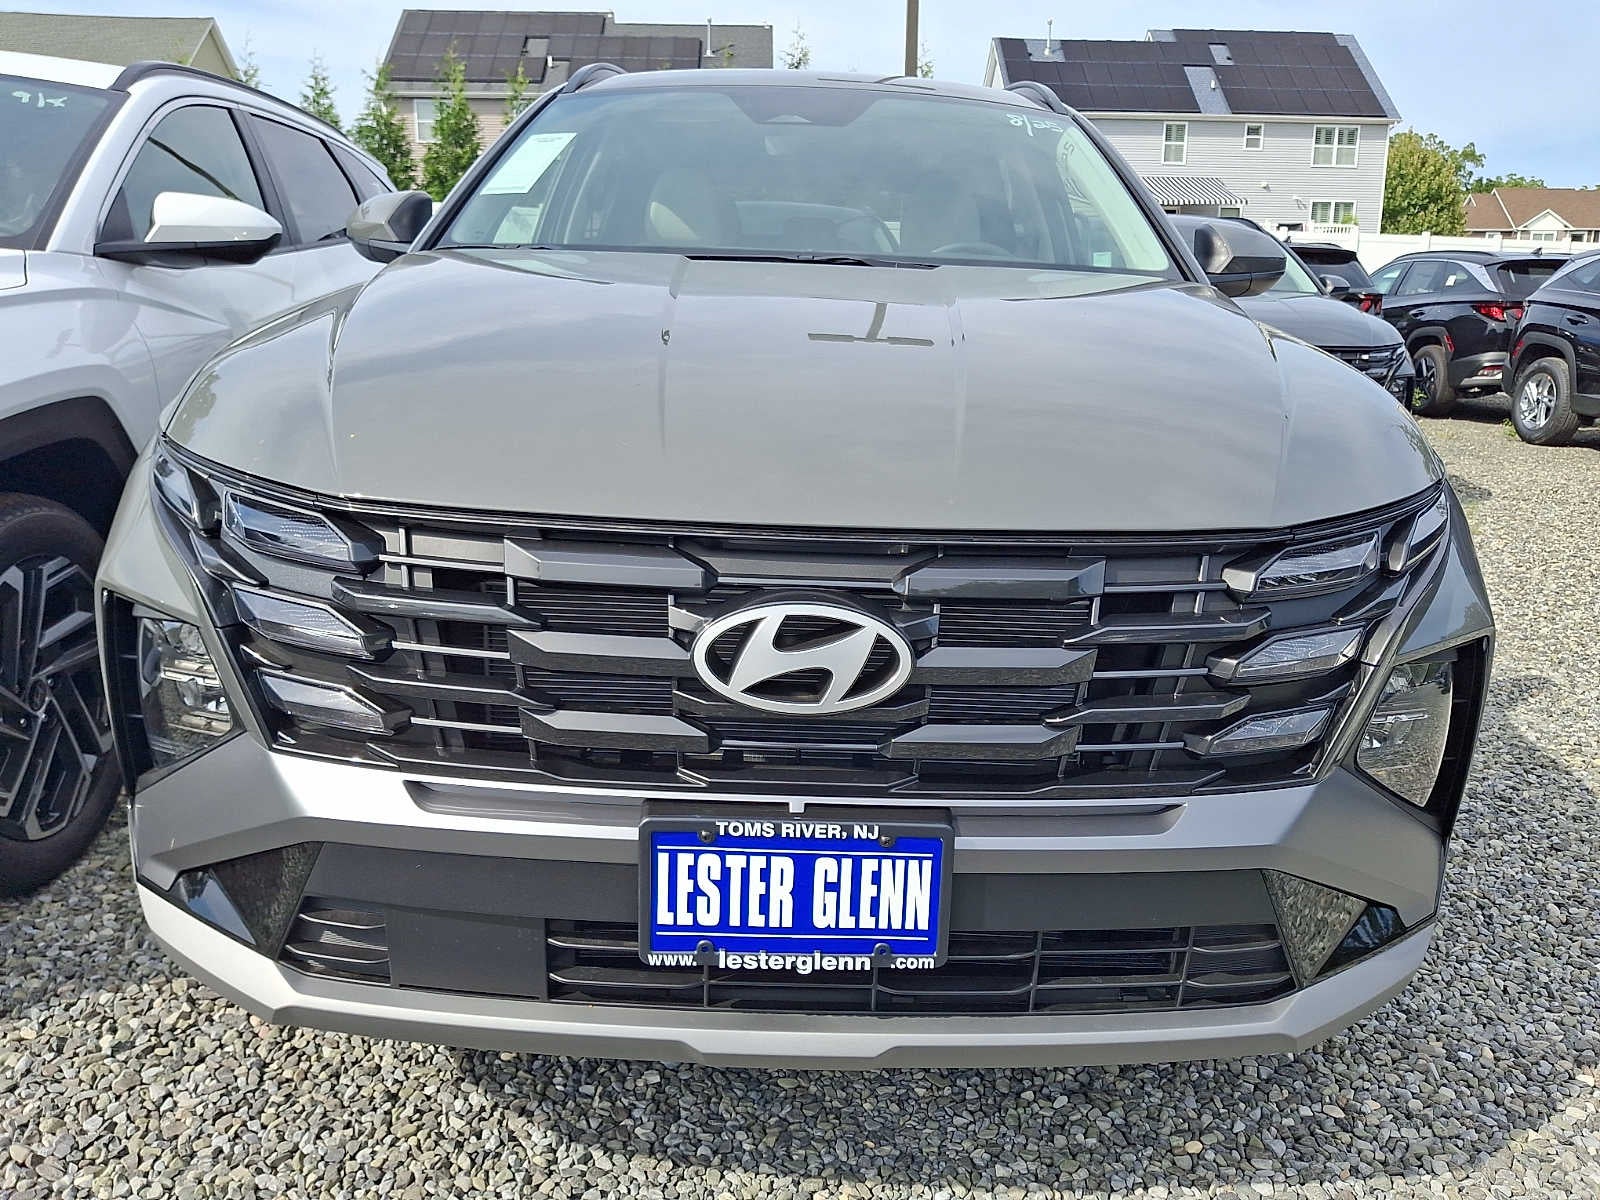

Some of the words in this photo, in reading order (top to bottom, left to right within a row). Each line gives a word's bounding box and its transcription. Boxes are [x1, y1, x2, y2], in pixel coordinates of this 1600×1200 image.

[715, 820, 775, 838] TOMS
[781, 820, 848, 840] RIVER,
[853, 823, 880, 840] NJ
[656, 852, 795, 928] LESTER
[812, 857, 933, 931] GLENN
[647, 953, 698, 967] www.
[718, 949, 871, 975] lesterglenn
